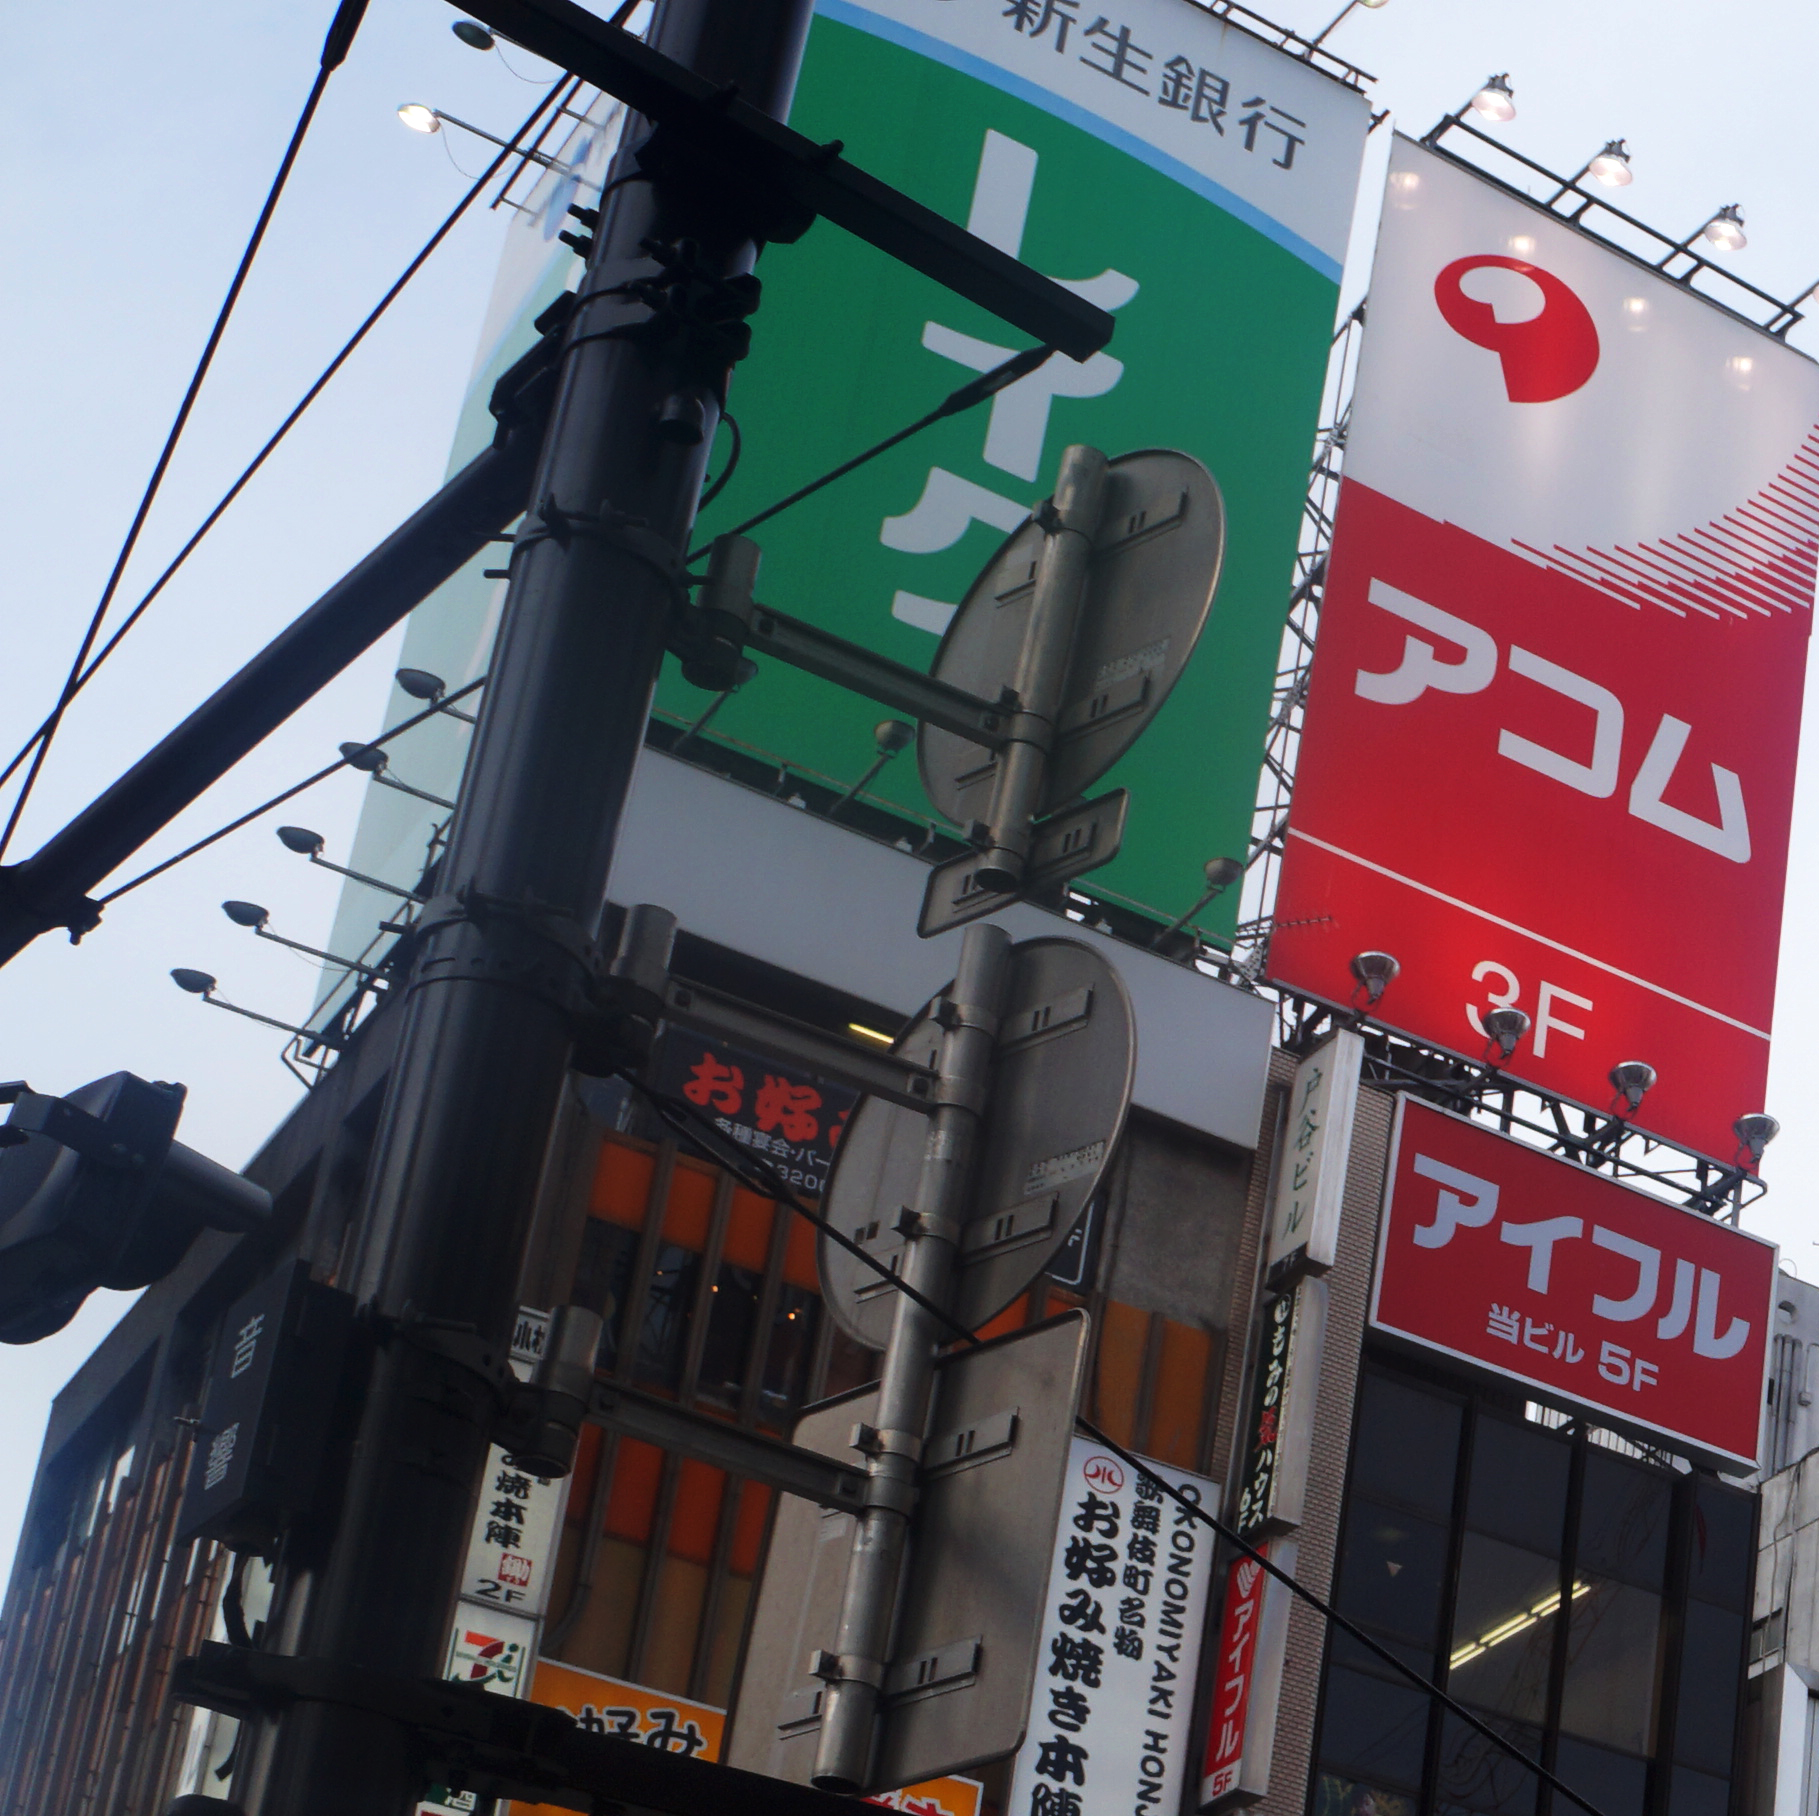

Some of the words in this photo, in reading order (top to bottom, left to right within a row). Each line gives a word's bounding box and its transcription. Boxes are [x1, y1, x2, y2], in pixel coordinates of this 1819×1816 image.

[1355, 576, 1752, 863] アコム
[1465, 960, 1593, 1059] 3F
[1413, 1153, 1750, 1359] アイフル
[1487, 1303, 1584, 1364] 当ビル
[1598, 1340, 1658, 1392] 5F
[477, 1578, 525, 1603] 2F
[1146, 1484, 1201, 1720] OKONOMIYAKI
[1216, 1608, 1254, 1763] アイフル
[1212, 1770, 1233, 1795] 5F
